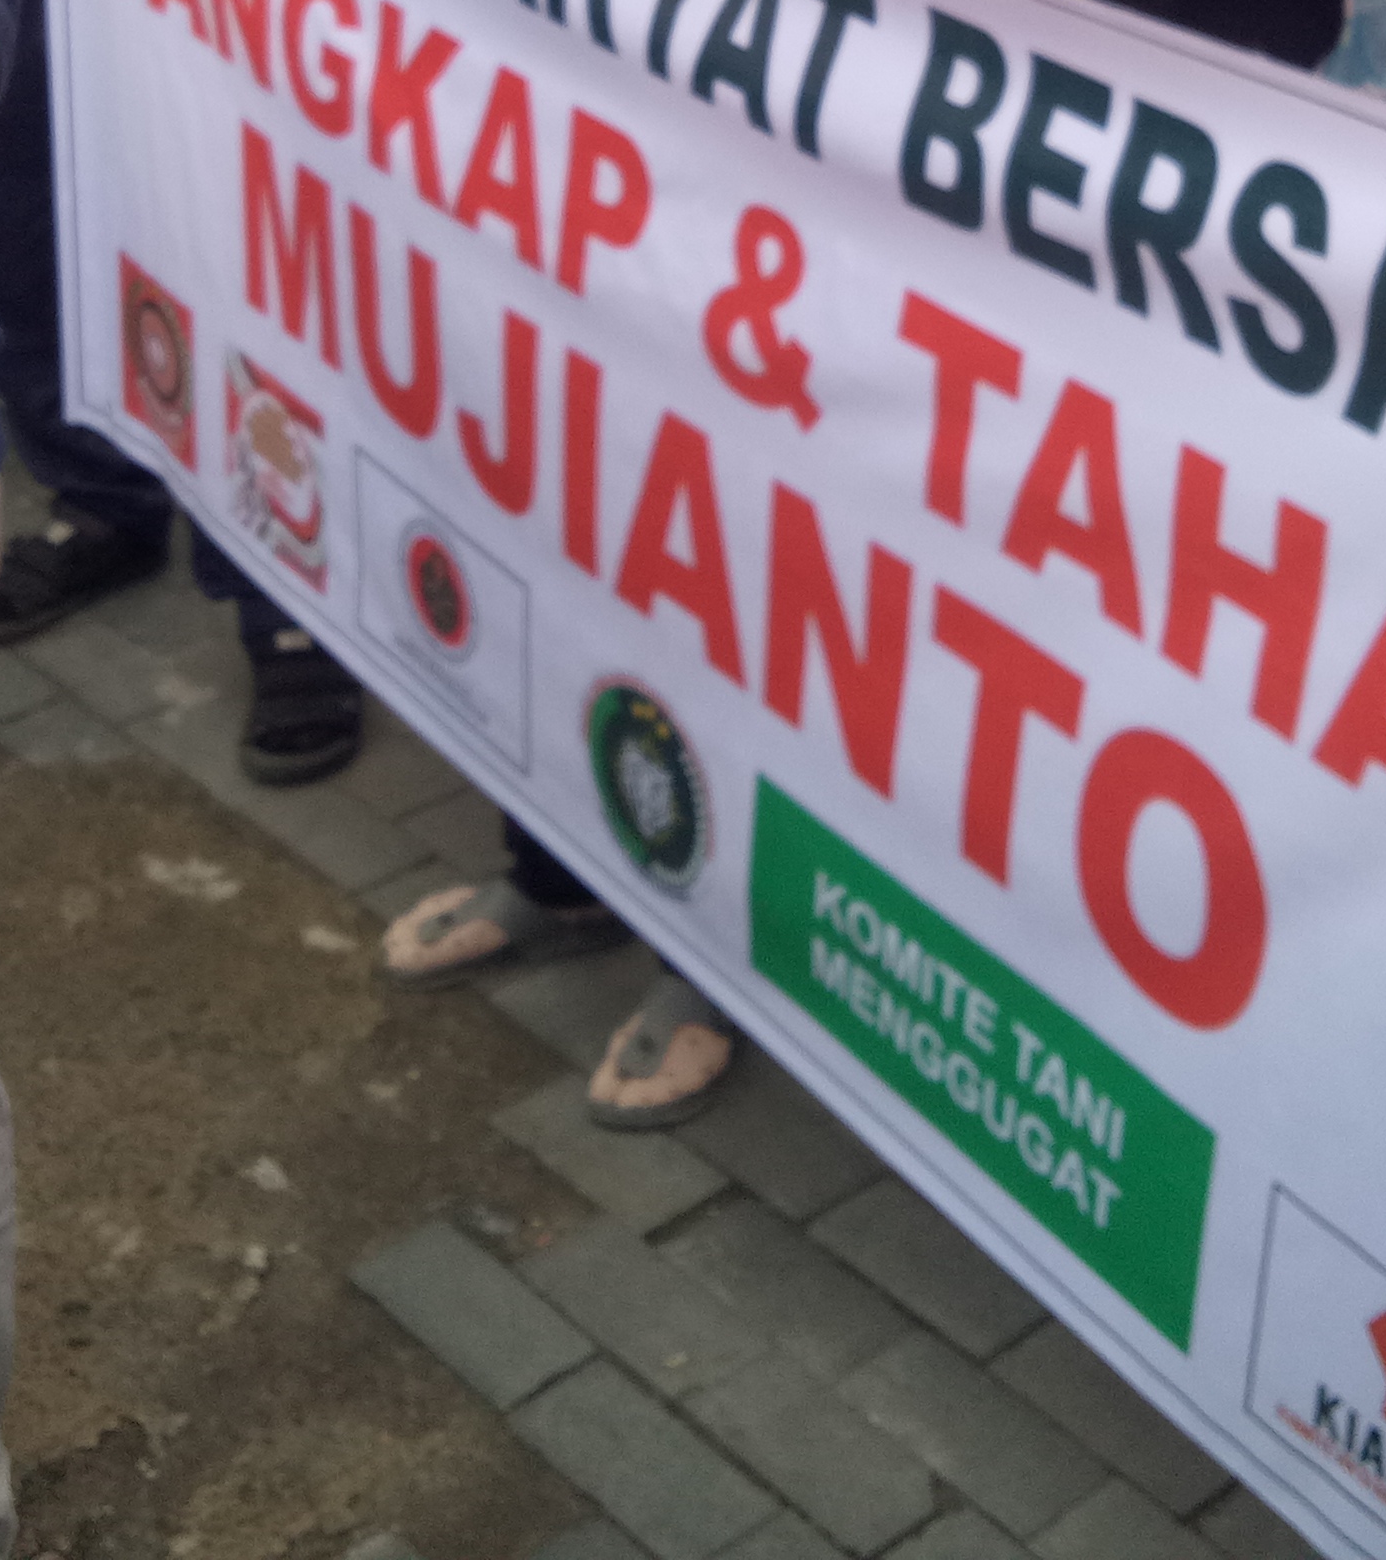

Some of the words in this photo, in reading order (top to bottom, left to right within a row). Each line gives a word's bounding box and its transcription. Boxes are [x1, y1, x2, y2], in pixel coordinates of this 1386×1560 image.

[701, 202, 823, 434] &
[239, 117, 1271, 1033] MUJIANTO
[809, 934, 1122, 1231] MENGGUGAT
[813, 870, 999, 1056] KOMITE
[1009, 1021, 1128, 1161] TANI
